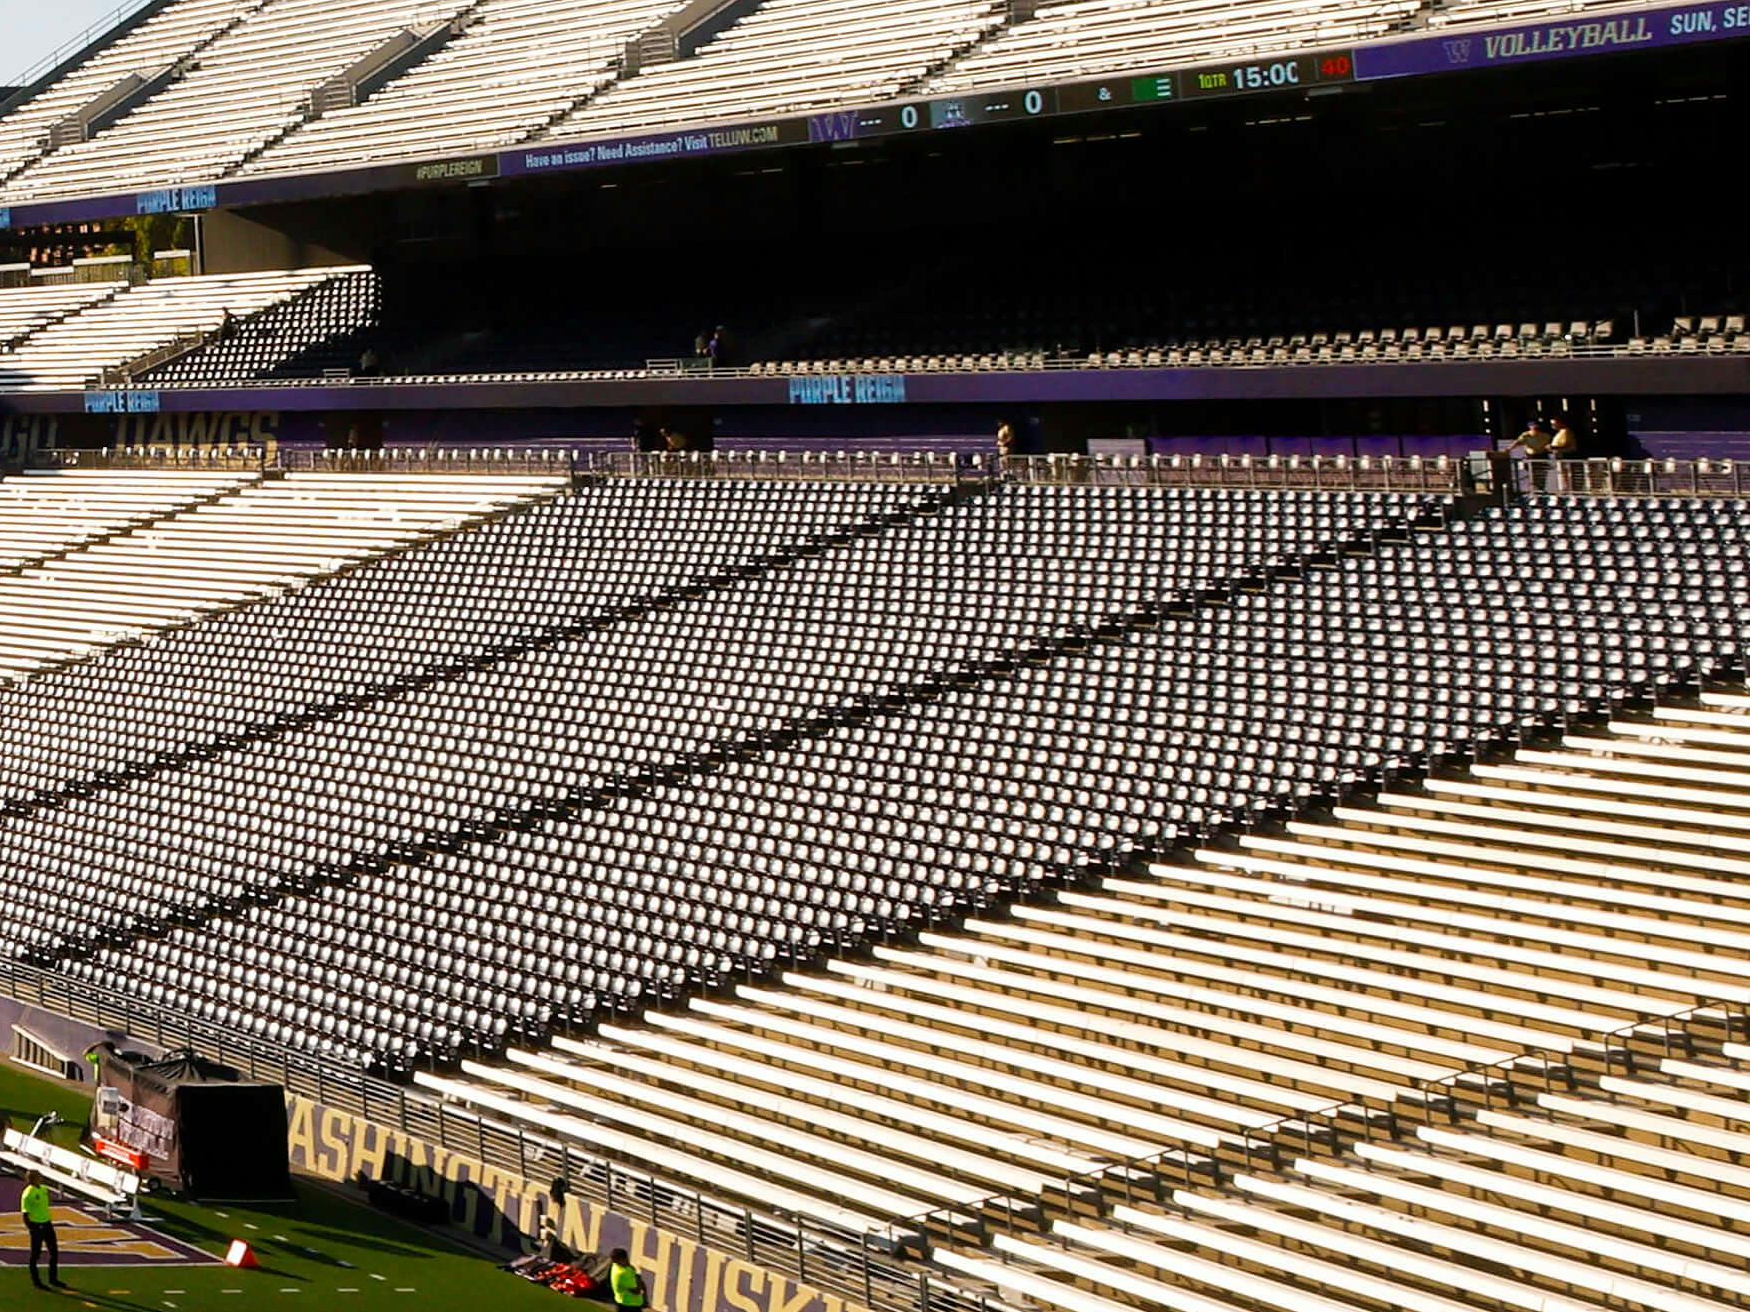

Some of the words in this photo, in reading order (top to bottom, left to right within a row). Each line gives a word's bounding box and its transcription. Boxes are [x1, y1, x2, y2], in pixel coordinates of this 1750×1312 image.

[1670, 10, 1718, 36] SUN,
[1484, 17, 1653, 60] VOLLEYBALL
[1320, 56, 1351, 76] 40
[1023, 90, 1044, 115] 0
[810, 111, 859, 143] W
[900, 105, 919, 130] 0
[525, 152, 549, 169] Have
[549, 153, 563, 166] an
[563, 148, 596, 165] issue?
[596, 144, 624, 162] Need
[624, 139, 684, 160] Assistance?
[684, 136, 709, 152] Visit
[416, 160, 483, 181] #PURPLEREIGN
[137, 189, 182, 214] PURPLE
[789, 375, 852, 404] PURPLE
[854, 375, 906, 404] REIGN
[85, 391, 127, 414] PURPLE
[285, 1090, 607, 1265] ASHINGTON
